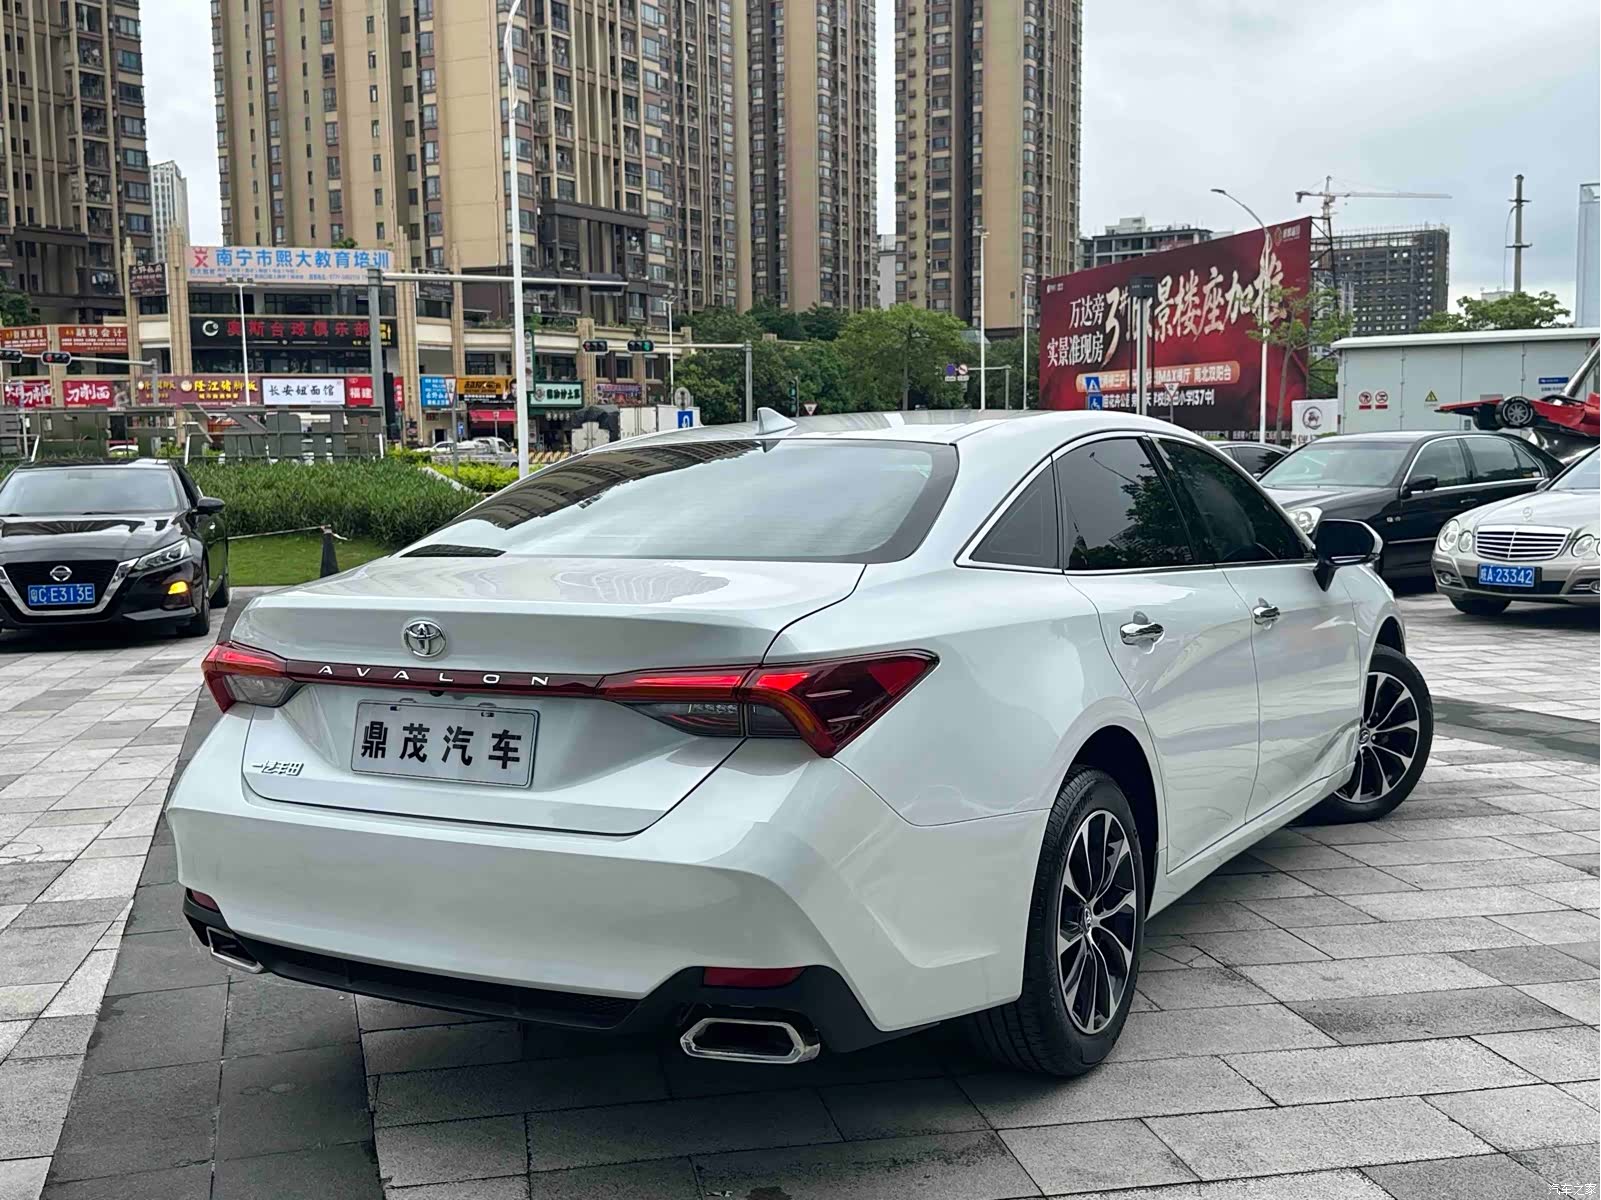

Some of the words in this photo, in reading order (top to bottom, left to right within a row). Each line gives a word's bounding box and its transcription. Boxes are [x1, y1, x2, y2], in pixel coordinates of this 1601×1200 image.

[215, 249, 390, 269] 南宁市熙大教育培训
[1068, 293, 1105, 329] 万达旁
[1046, 331, 1104, 368] 实景准现房
[66, 383, 111, 402] 刀削面
[194, 380, 259, 392] 隆江猪脚饭
[349, 387, 373, 399] 福建
[317, 664, 550, 687] AVALON
[360, 720, 523, 770] 鼎茂汽车
[251, 760, 304, 777] 一汽丰田
